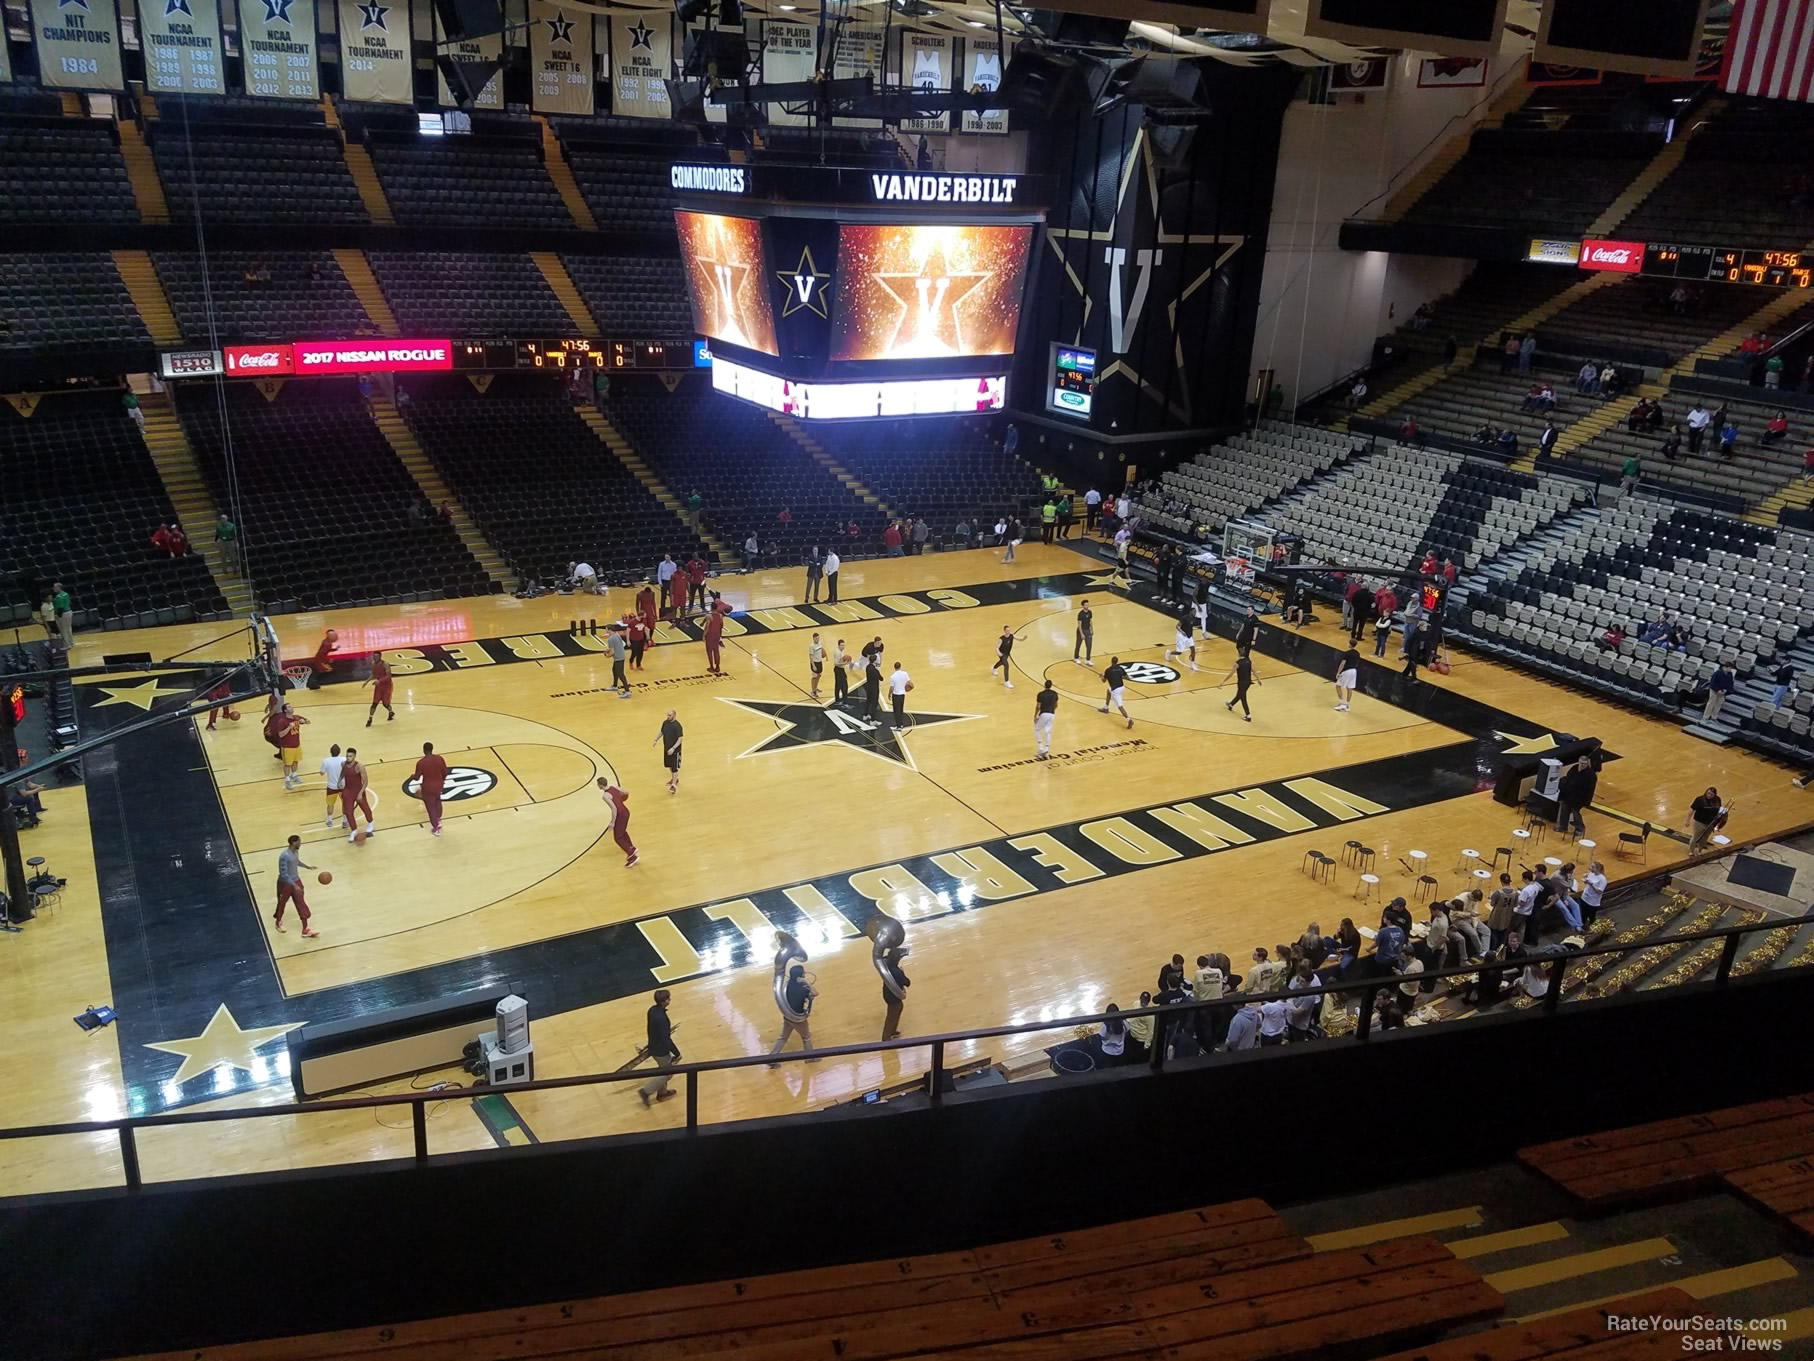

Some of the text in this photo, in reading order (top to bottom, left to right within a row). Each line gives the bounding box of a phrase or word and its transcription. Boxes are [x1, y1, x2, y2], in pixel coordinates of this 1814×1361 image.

[367, 6, 380, 22] V
[64, 14, 85, 28] NIT
[43, 27, 111, 43] CHAMPIONS
[168, 23, 193, 35] NCAA
[556, 22, 565, 36] V
[786, 28, 811, 38] PLAYER
[150, 34, 213, 48] TOURNAMENT
[267, 30, 291, 41] NCAA
[364, 36, 386, 47] NCAA
[636, 29, 646, 42] V
[912, 36, 945, 47] SCHOLTENS
[250, 40, 309, 54] TOURNAMENT
[460, 43, 480, 54] NCAA
[769, 37, 811, 48] OF THE YEAR
[190, 50, 213, 61] 1987
[348, 46, 403, 60] TOURNAMENT
[552, 50, 572, 60] NCAA
[61, 57, 98, 73] 1984
[253, 54, 310, 67] 2006 2007
[350, 60, 373, 71] 2014
[632, 56, 651, 66] NCAA
[156, 61, 180, 73] 1989
[544, 62, 580, 72] SWEET 16
[622, 66, 662, 78] ELITE EIGHT
[254, 68, 310, 81] 2010 2011
[539, 73, 559, 82] 2005
[192, 77, 217, 89] 2003
[255, 83, 312, 95] 2012 2013
[620, 78, 639, 88] 1992
[539, 85, 559, 95] 2009
[620, 90, 639, 100] 2001
[671, 166, 745, 193] COMMODORES
[872, 174, 1016, 203] VANDERBILT
[1726, 254, 1735, 265] 4
[1765, 252, 1799, 267] 47:56
[1729, 268, 1739, 280] 0
[1754, 271, 1763, 283] 0
[1800, 275, 1809, 287] 0
[795, 275, 815, 303] V
[1104, 247, 1163, 354] V
[528, 343, 536, 353] 4
[562, 340, 590, 350] 47:56
[616, 344, 623, 353] 4
[303, 349, 446, 364] 2017 NISSAN ROGUE
[535, 356, 543, 366] 0
[558, 356, 565, 367] 0
[597, 356, 603, 367] 0
[616, 356, 623, 366] 0
[173, 358, 212, 368] 1510
[477, 376, 487, 386] C
[667, 376, 675, 385] D
[265, 383, 274, 393] B
[655, 672, 730, 687] Memorial
[1074, 738, 1149, 757] Memorial
[634, 776, 1392, 984] VANDERBILT
